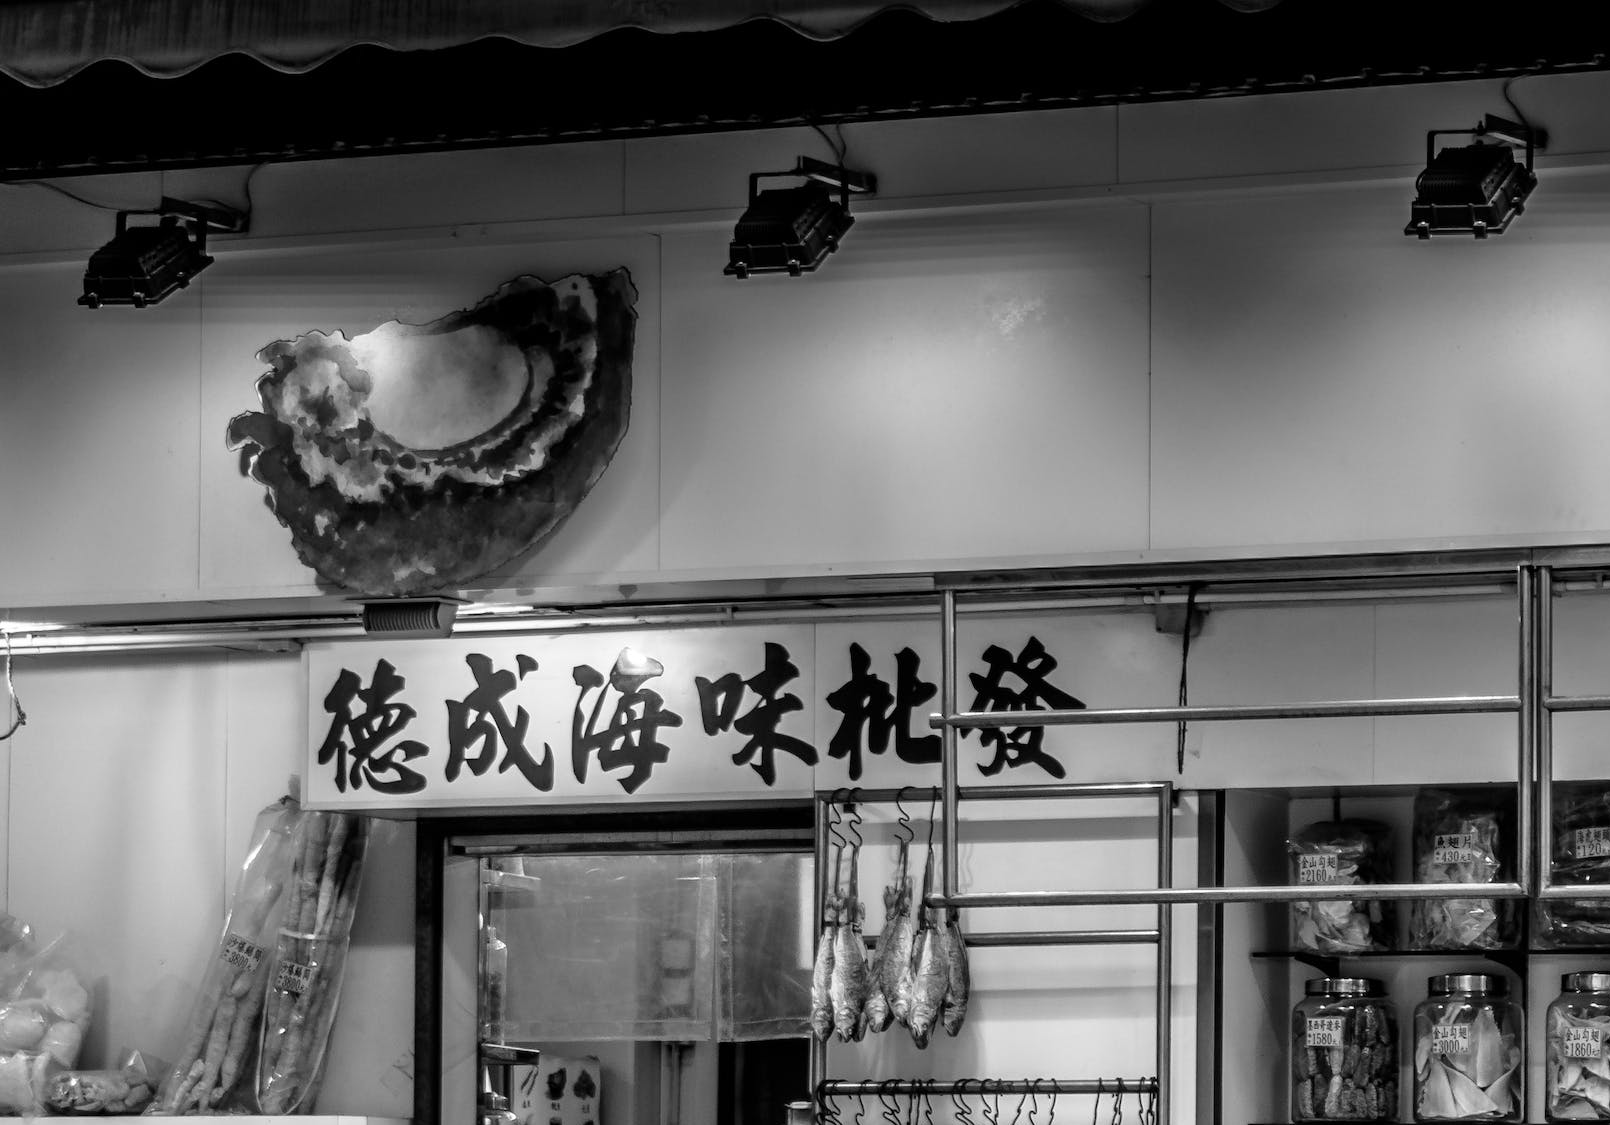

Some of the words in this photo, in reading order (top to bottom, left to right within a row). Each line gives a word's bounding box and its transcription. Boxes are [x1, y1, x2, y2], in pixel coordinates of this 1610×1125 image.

[317, 636, 1087, 794] 德成海味批發
[1442, 850, 1459, 862] 430
[1306, 868, 1327, 882] 2160
[1312, 1032, 1333, 1046] 1580
[1438, 1040, 1460, 1054] 3000
[1569, 1042, 1592, 1057] 1860
